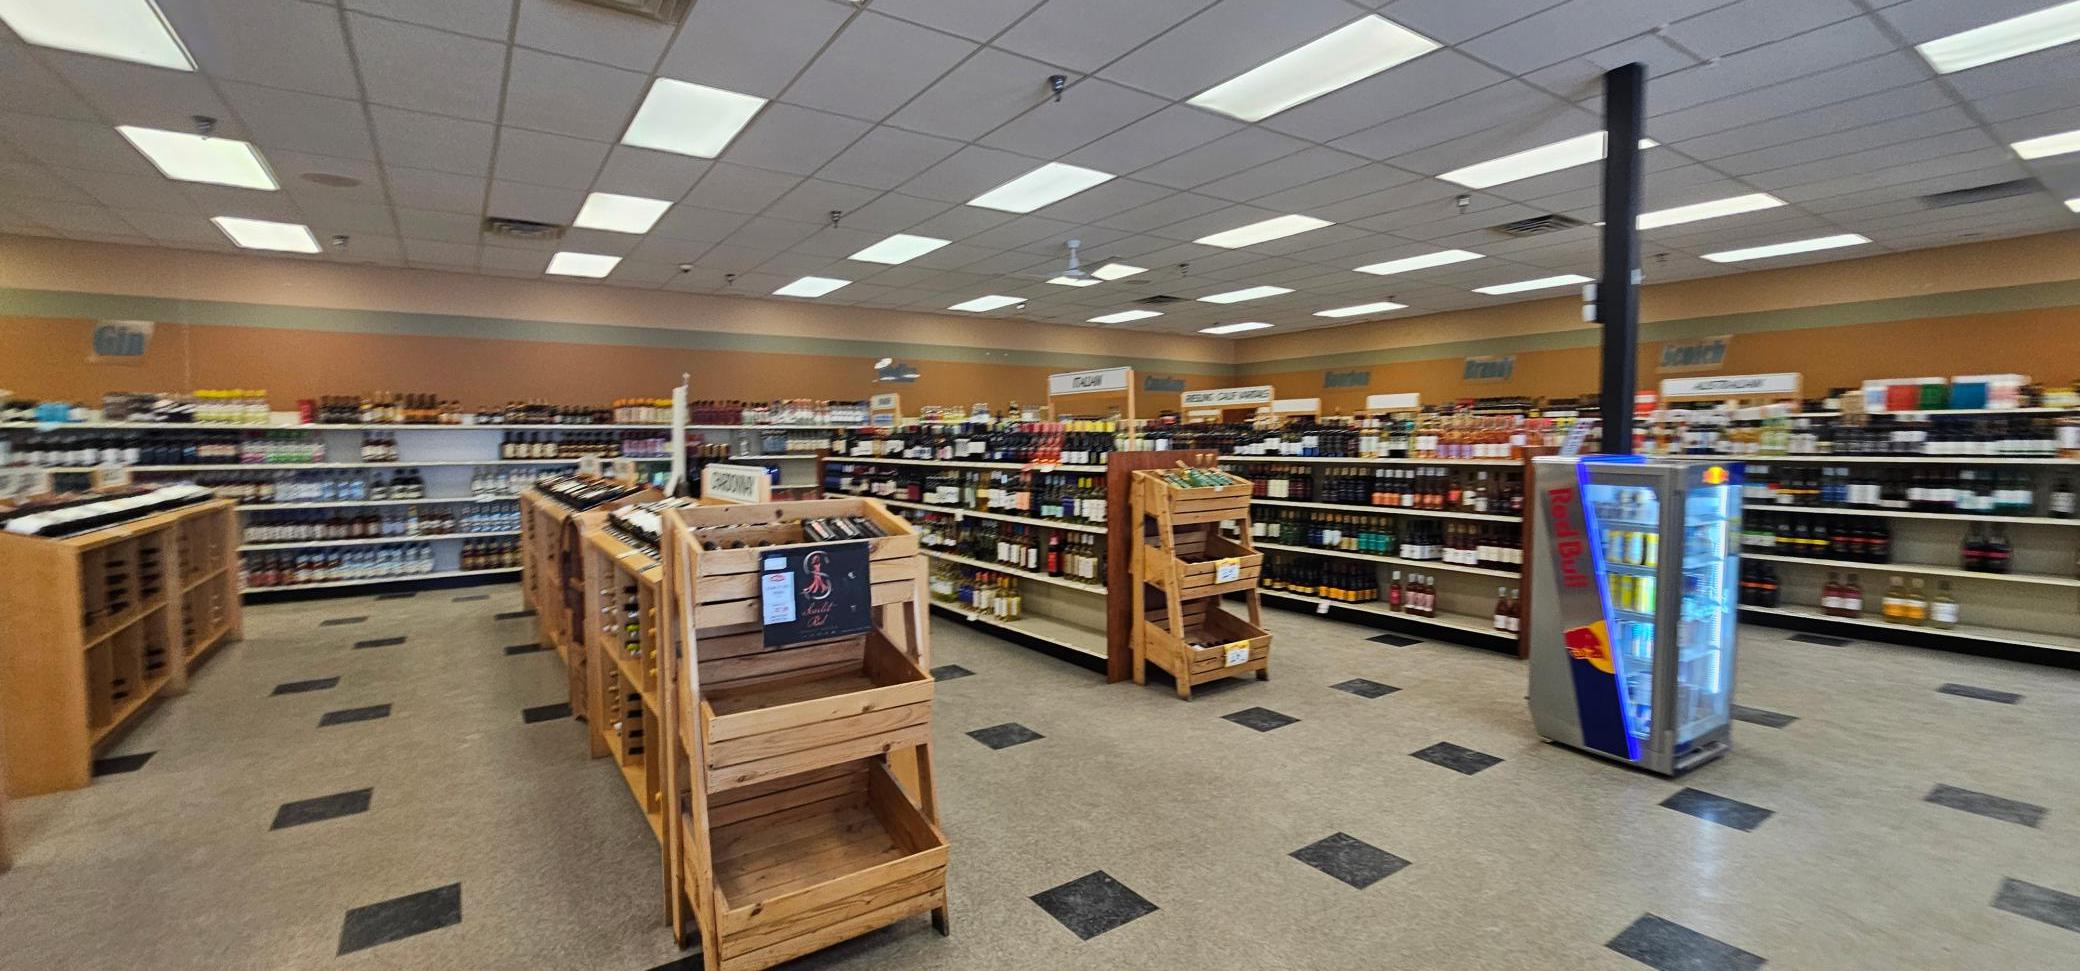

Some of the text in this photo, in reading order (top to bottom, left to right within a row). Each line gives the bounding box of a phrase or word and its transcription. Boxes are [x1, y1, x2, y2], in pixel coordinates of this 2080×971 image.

[93, 324, 145, 356] Gin
[1072, 375, 1103, 389] ITALIAN
[1548, 487, 1580, 538] Red
[1557, 540, 1590, 588] Bull
